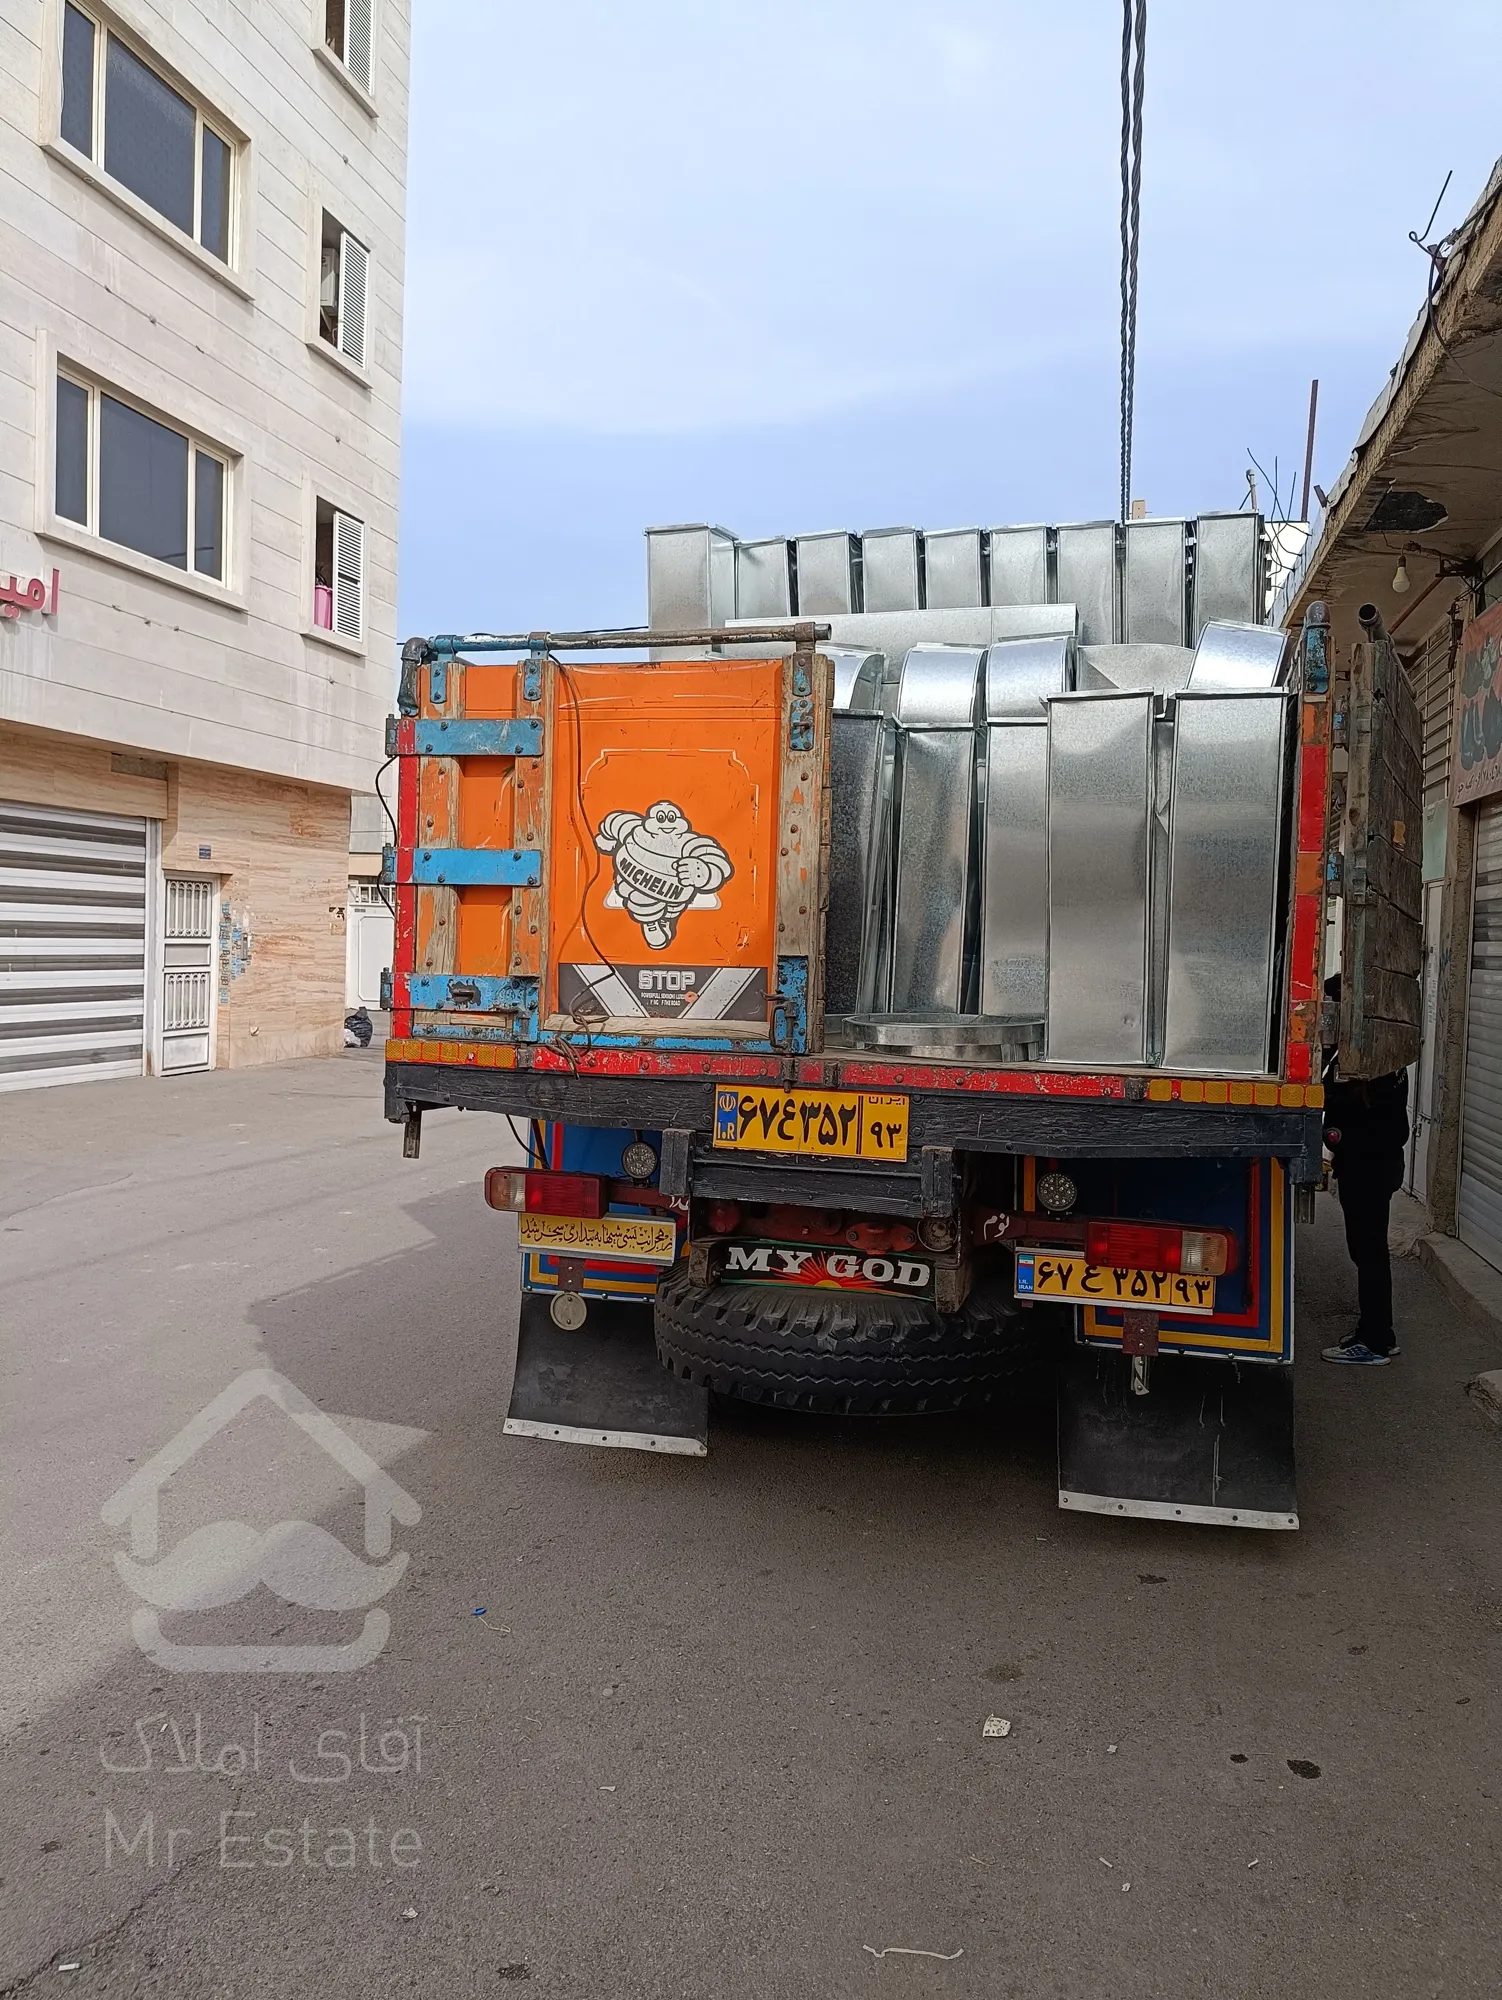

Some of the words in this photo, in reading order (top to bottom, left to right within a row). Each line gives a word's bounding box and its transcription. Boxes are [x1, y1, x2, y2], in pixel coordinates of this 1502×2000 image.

[0, 568, 60, 620] امی
[619, 856, 685, 901] MICHELIN
[638, 969, 696, 991] STOP
[868, 1095, 906, 1106] ایران
[869, 1121, 902, 1149] ۹۳
[725, 1246, 812, 1274] MY
[826, 1254, 931, 1287] GOD
